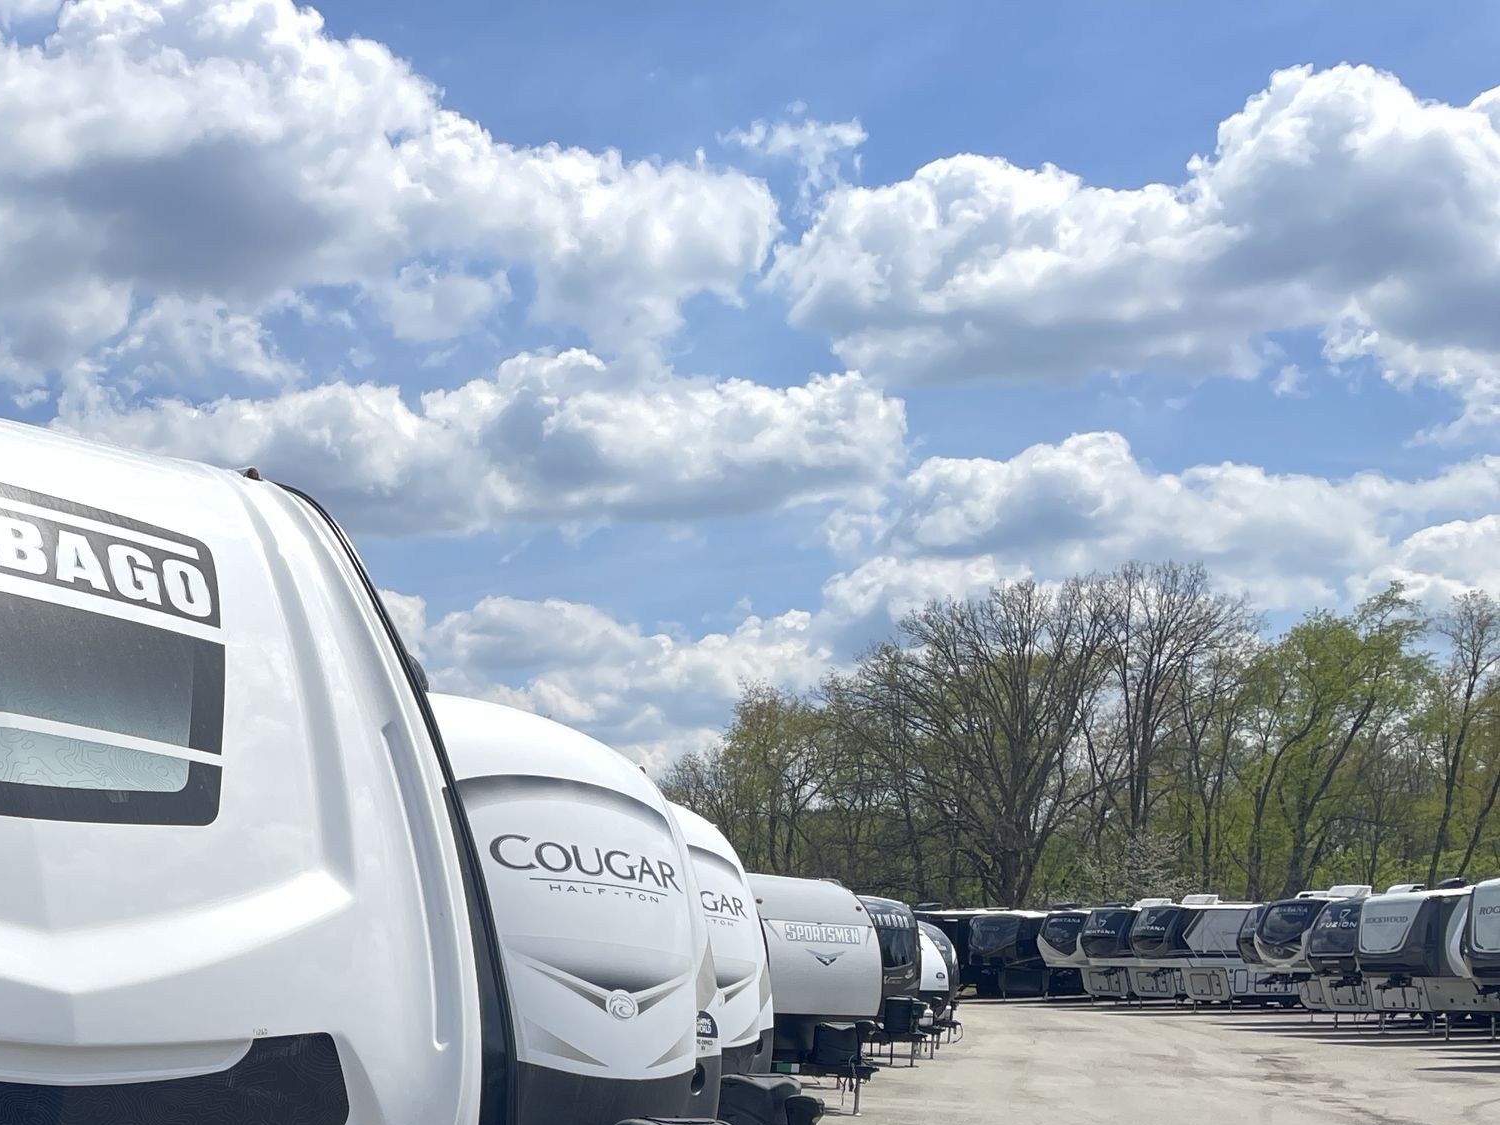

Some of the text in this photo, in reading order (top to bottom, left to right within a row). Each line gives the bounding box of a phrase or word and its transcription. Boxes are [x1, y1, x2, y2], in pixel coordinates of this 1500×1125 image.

[489, 834, 684, 894] COUGAR
[549, 883, 660, 904] HALF-TON
[700, 890, 748, 920] GAR
[870, 913, 910, 929] CKWOOD
[1319, 921, 1358, 929] FUZION
[785, 923, 861, 944] SPORTSMEN
